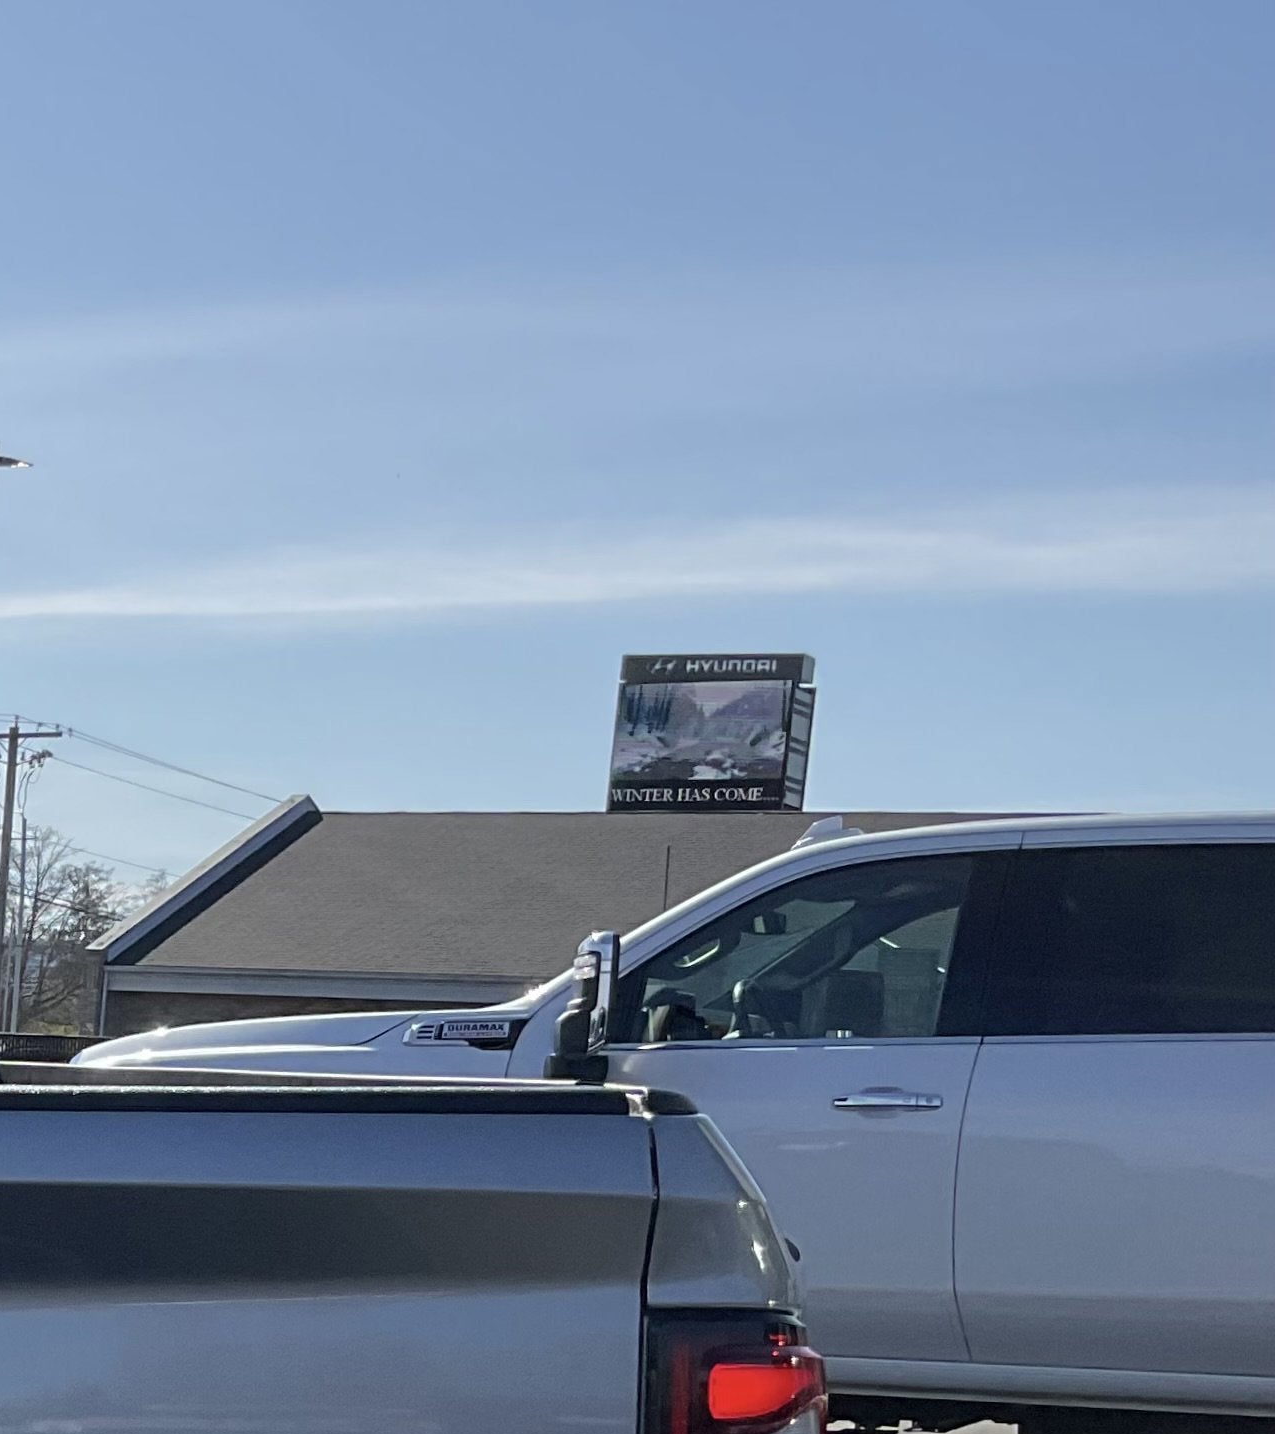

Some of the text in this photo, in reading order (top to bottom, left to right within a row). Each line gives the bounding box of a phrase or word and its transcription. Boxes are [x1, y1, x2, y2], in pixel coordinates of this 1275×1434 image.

[685, 659, 777, 673] HYUNDAI
[611, 788, 673, 802] WINTER
[677, 788, 710, 802] HAS
[447, 1023, 504, 1031] DURAMAX
